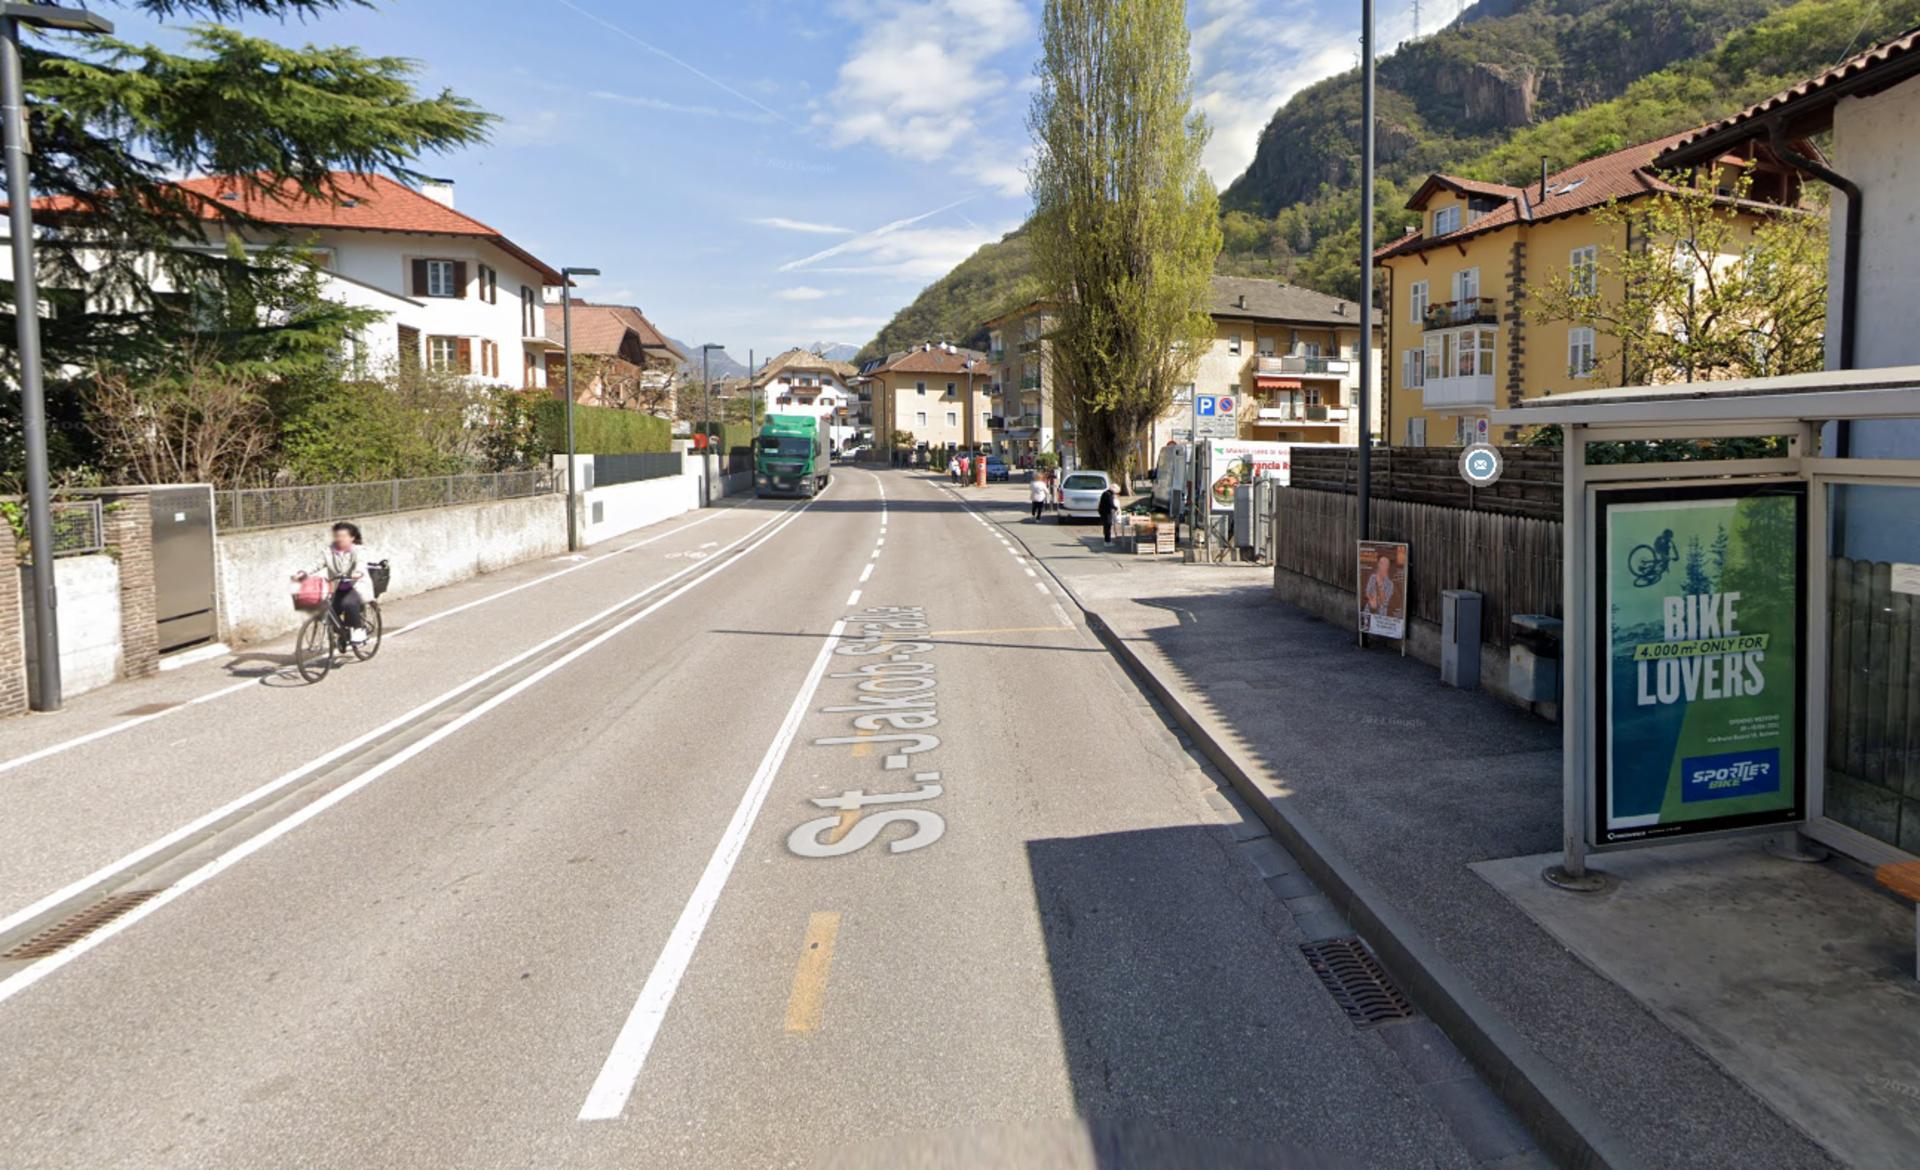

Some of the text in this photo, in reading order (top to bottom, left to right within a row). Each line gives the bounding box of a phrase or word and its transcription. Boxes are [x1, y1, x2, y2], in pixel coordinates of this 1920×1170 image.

[1200, 398, 1212, 414] P
[1664, 591, 1740, 641] BIKE
[1640, 644, 1679, 657] 4.000
[1700, 639, 1736, 653] ONLY
[1738, 636, 1763, 649] FOR
[1637, 651, 1765, 706] LOVERS
[1692, 762, 1770, 782] SPORTLER
